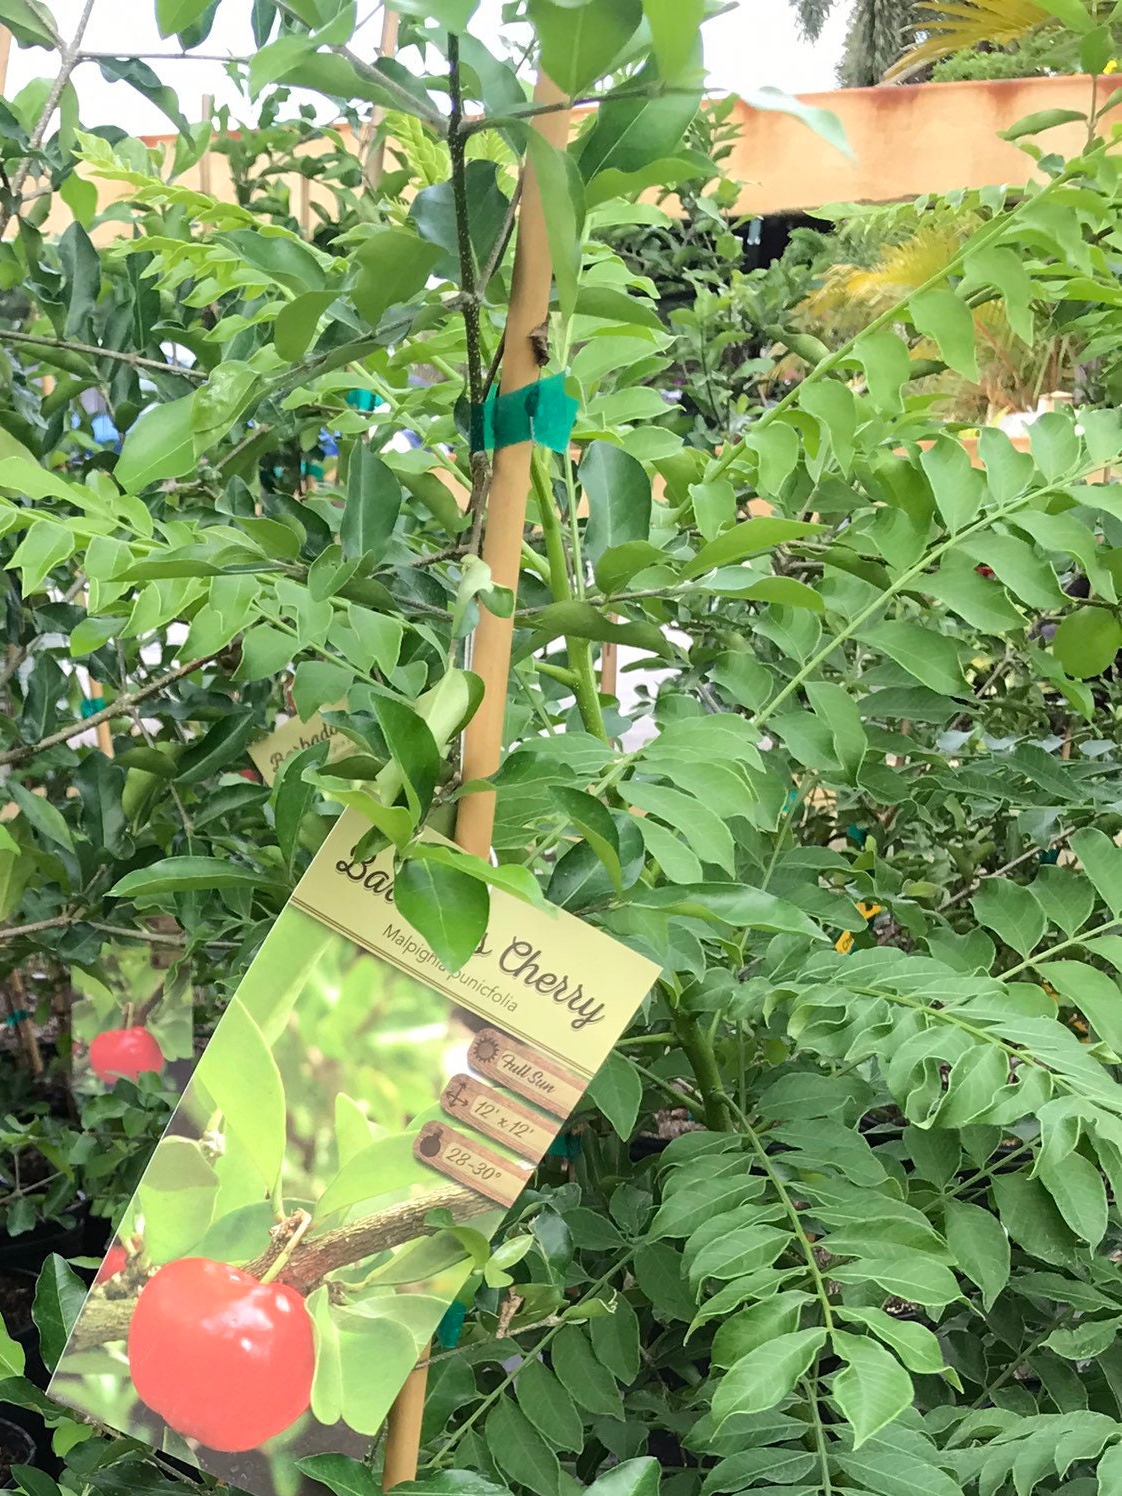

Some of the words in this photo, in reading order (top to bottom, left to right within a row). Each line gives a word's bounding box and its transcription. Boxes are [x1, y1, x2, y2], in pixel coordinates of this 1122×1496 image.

[498, 936, 606, 1030] Cherry
[500, 1053, 532, 1083] Full
[528, 1071, 556, 1094] Sun
[473, 1100, 500, 1121] 12'
[497, 1117, 510, 1128] x
[505, 1120, 535, 1141] 12'
[445, 1147, 502, 1182] 28-30°
